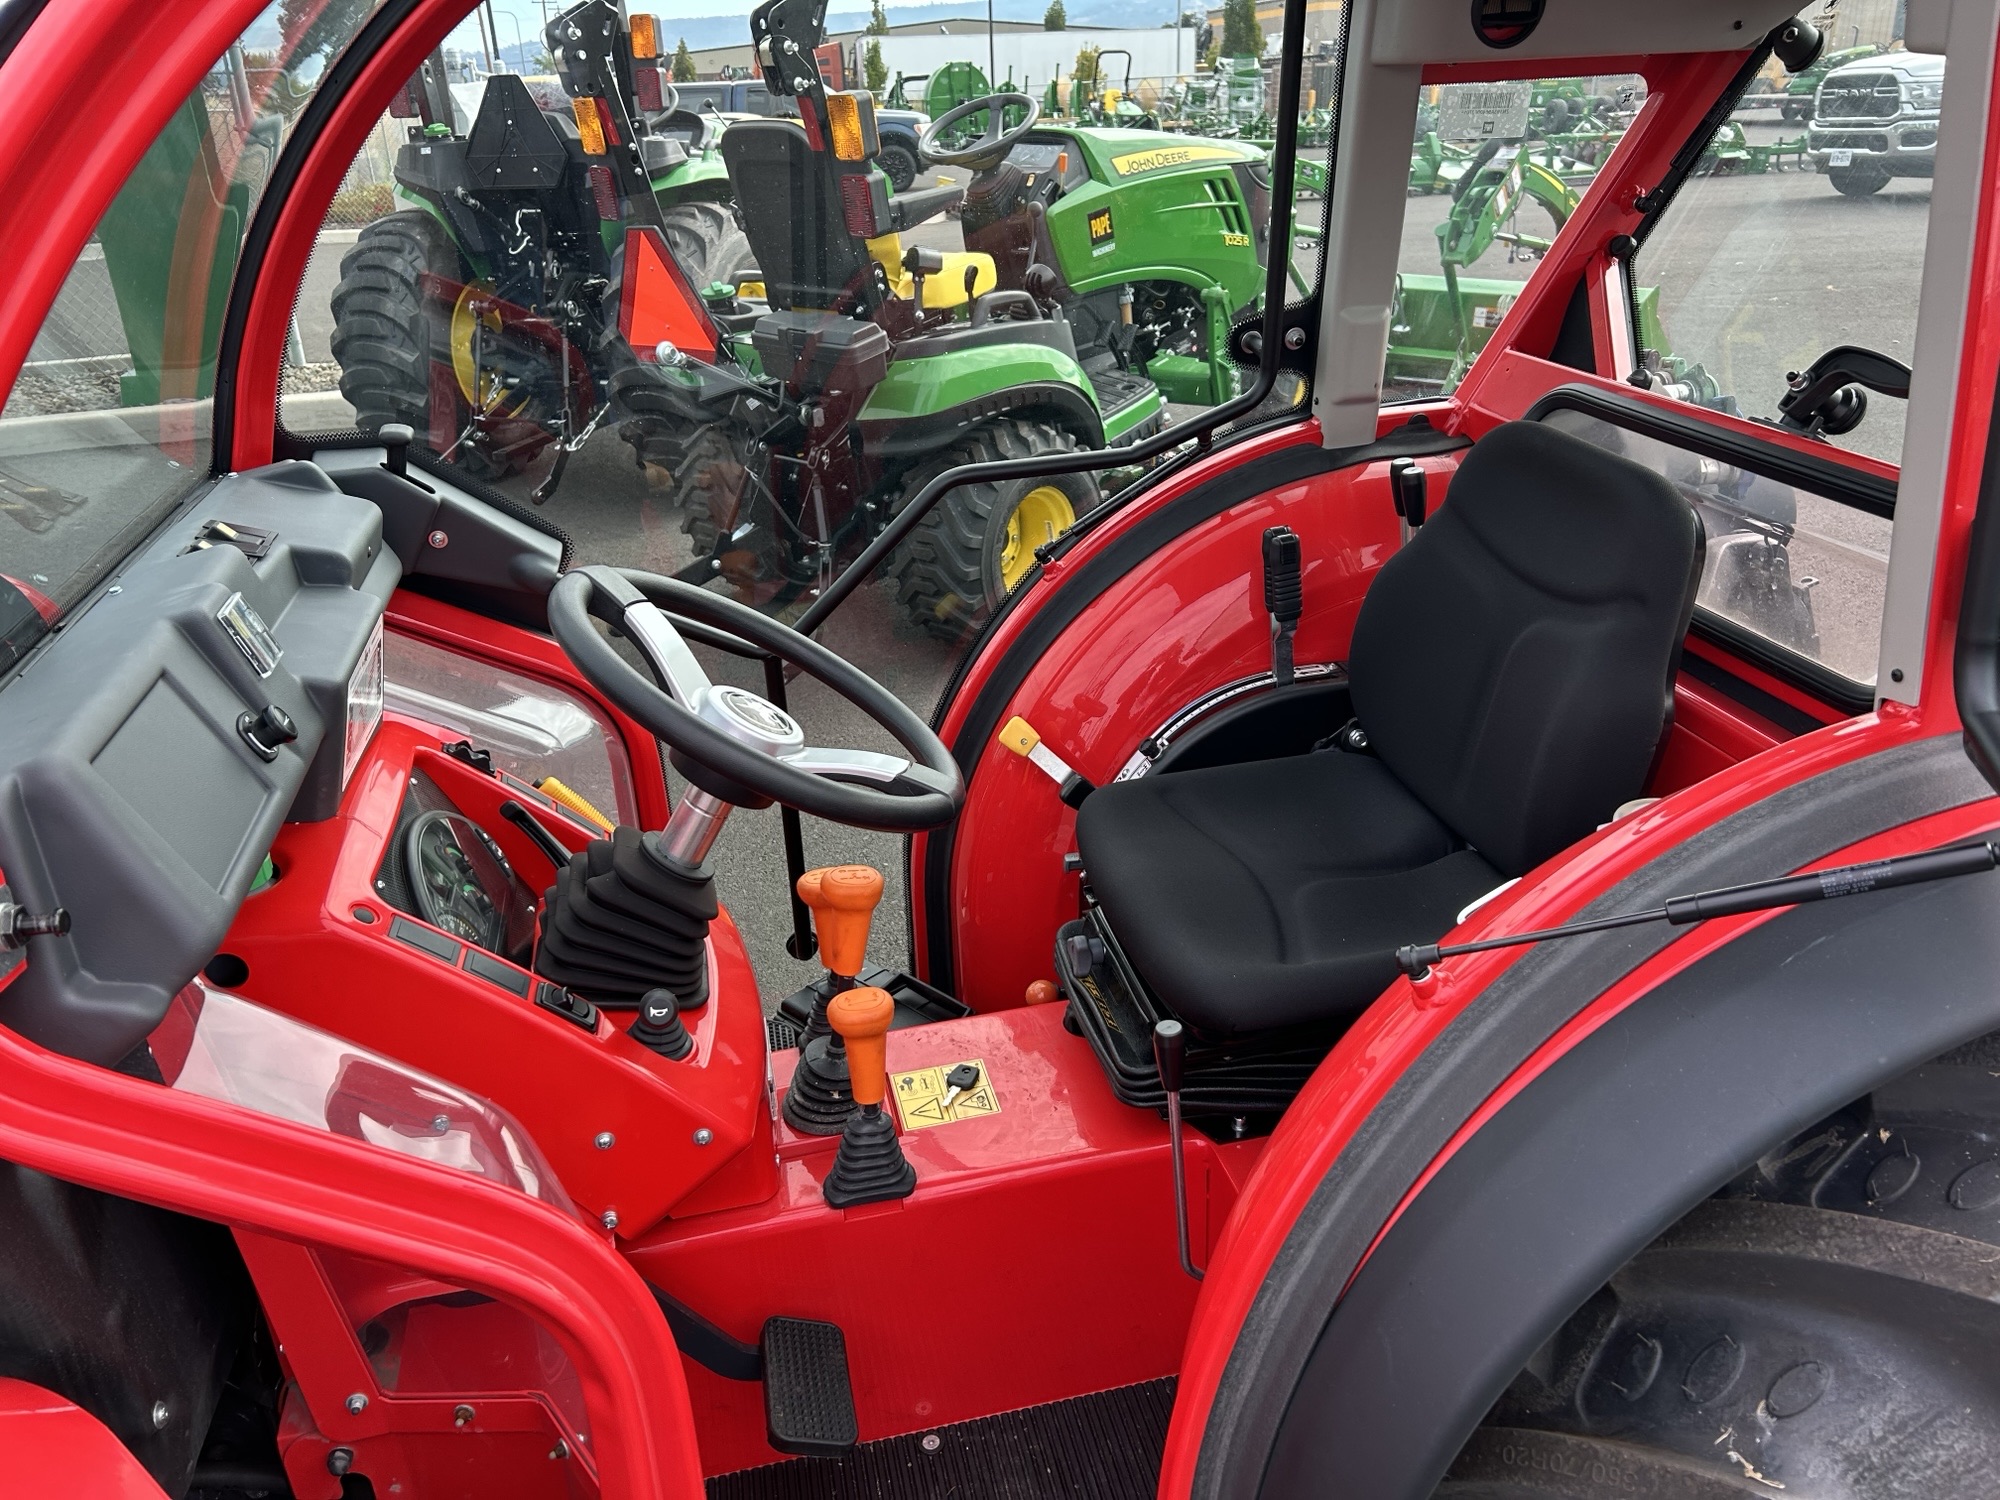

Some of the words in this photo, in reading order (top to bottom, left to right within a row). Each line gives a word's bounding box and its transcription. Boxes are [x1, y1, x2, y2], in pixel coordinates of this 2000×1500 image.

[1837, 88, 1872, 97] RAM
[1126, 157, 1155, 173] JOHN
[1155, 151, 1191, 166] DEERE
